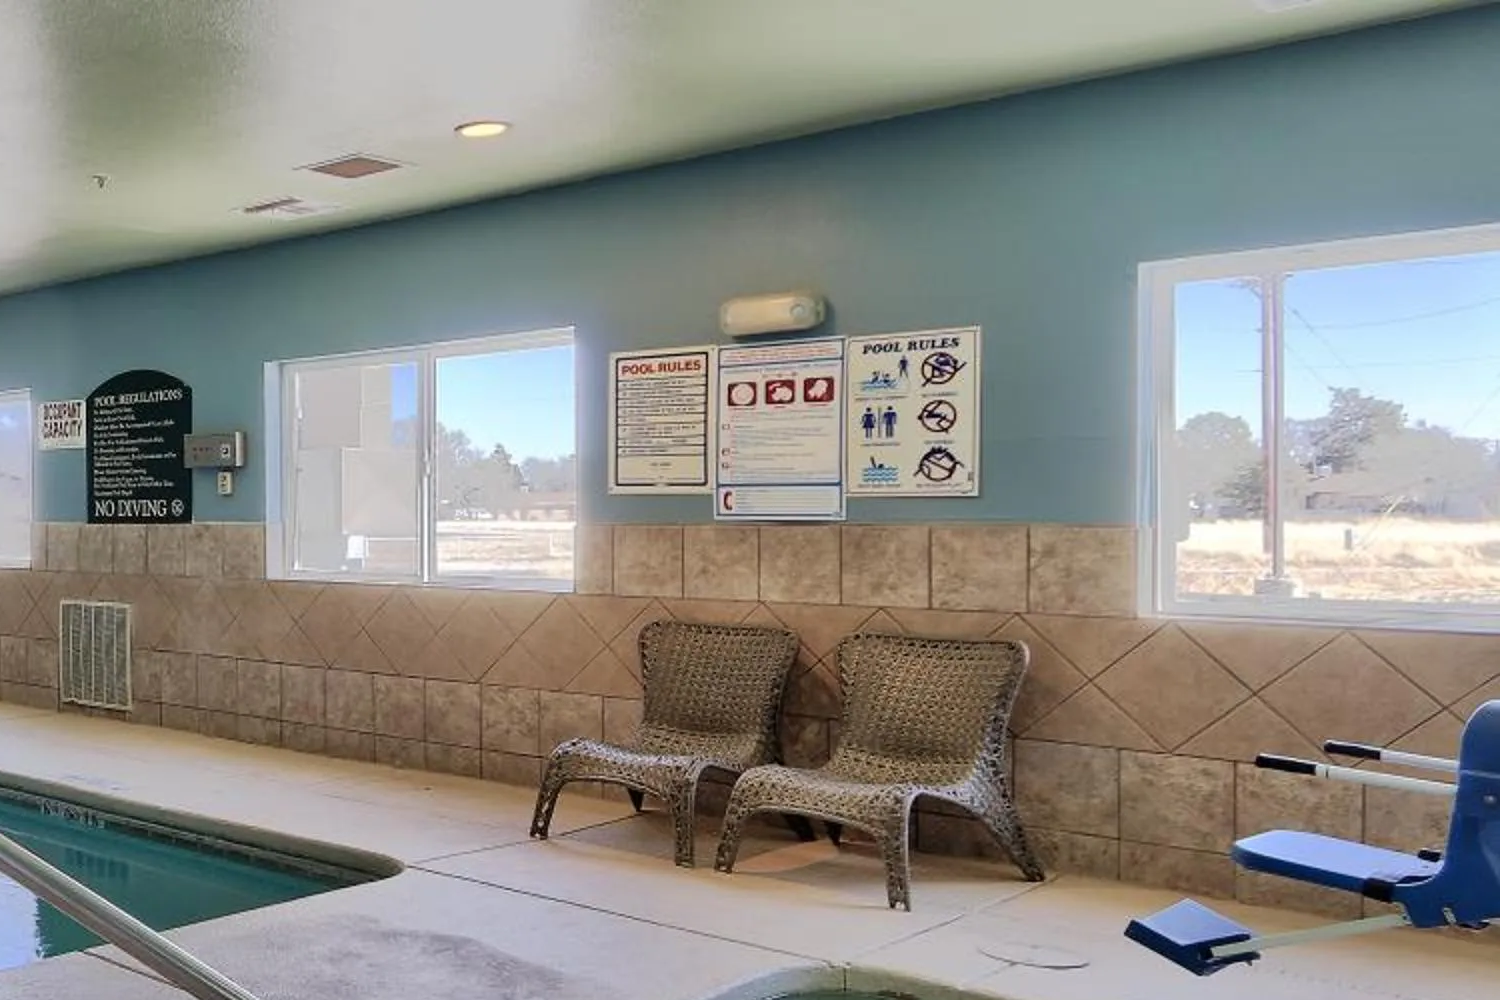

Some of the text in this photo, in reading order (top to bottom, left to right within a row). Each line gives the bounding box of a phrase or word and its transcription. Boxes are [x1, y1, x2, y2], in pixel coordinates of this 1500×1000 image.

[862, 338, 960, 354] POOL RULES
[621, 360, 702, 375] POOL RULES
[119, 388, 183, 405] REGULATIONS
[43, 402, 81, 420] OCCUPANT
[43, 420, 82, 438] CAPACITY
[95, 499, 168, 517] NO DIVING
